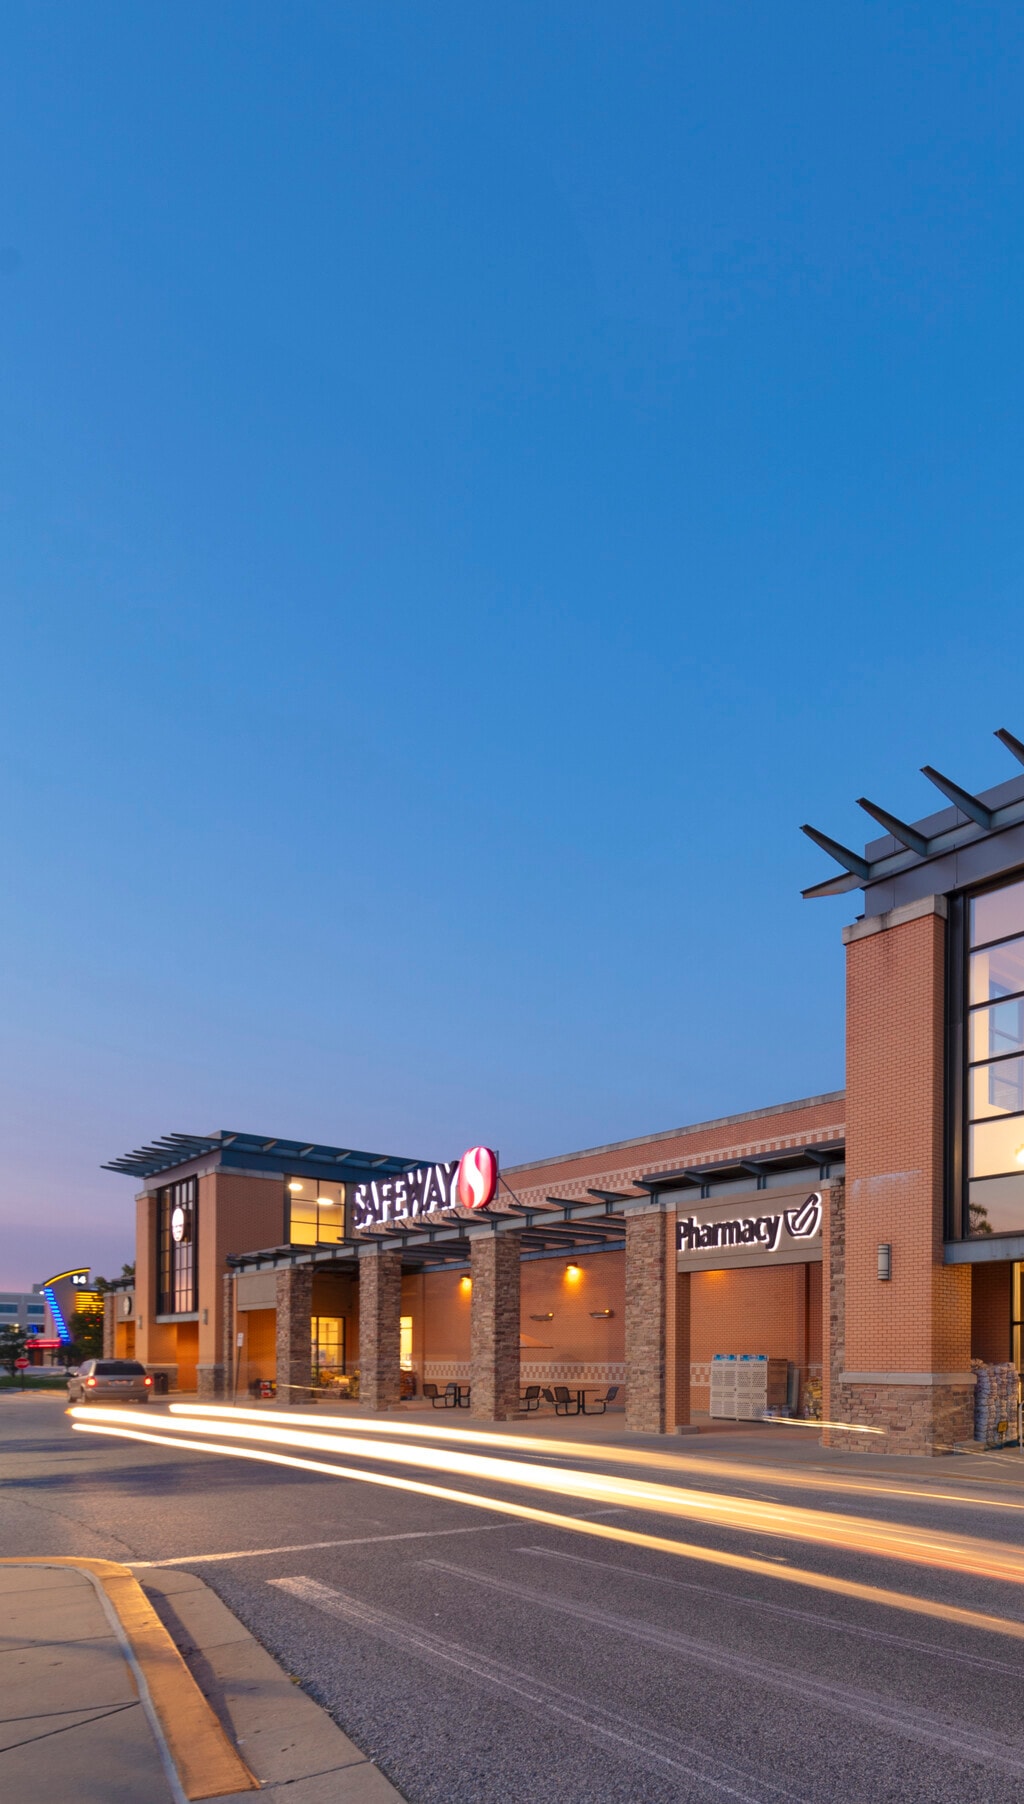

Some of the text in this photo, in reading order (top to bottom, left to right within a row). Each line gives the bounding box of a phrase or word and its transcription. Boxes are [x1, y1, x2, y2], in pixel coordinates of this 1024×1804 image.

[353, 1160, 461, 1229] SAFEWAY
[676, 1215, 783, 1252] Pharmacy
[72, 1275, 87, 1284] 14
